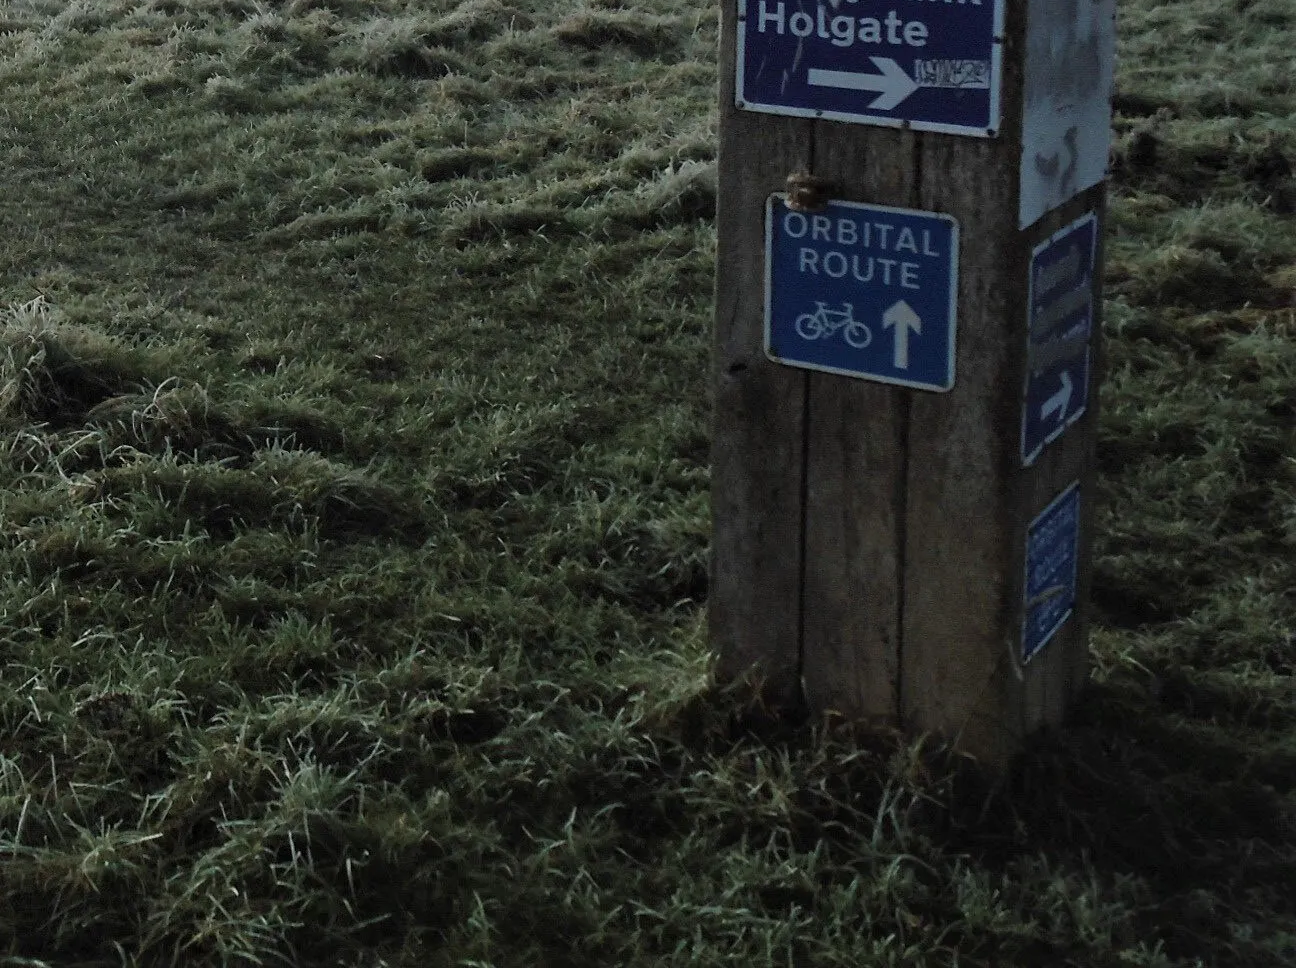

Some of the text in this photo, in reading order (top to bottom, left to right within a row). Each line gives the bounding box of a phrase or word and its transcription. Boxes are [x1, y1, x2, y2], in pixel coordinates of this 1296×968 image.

[757, 0, 930, 46] Holgate
[783, 211, 941, 258] ORBITAL
[799, 246, 921, 290] ROUTE
